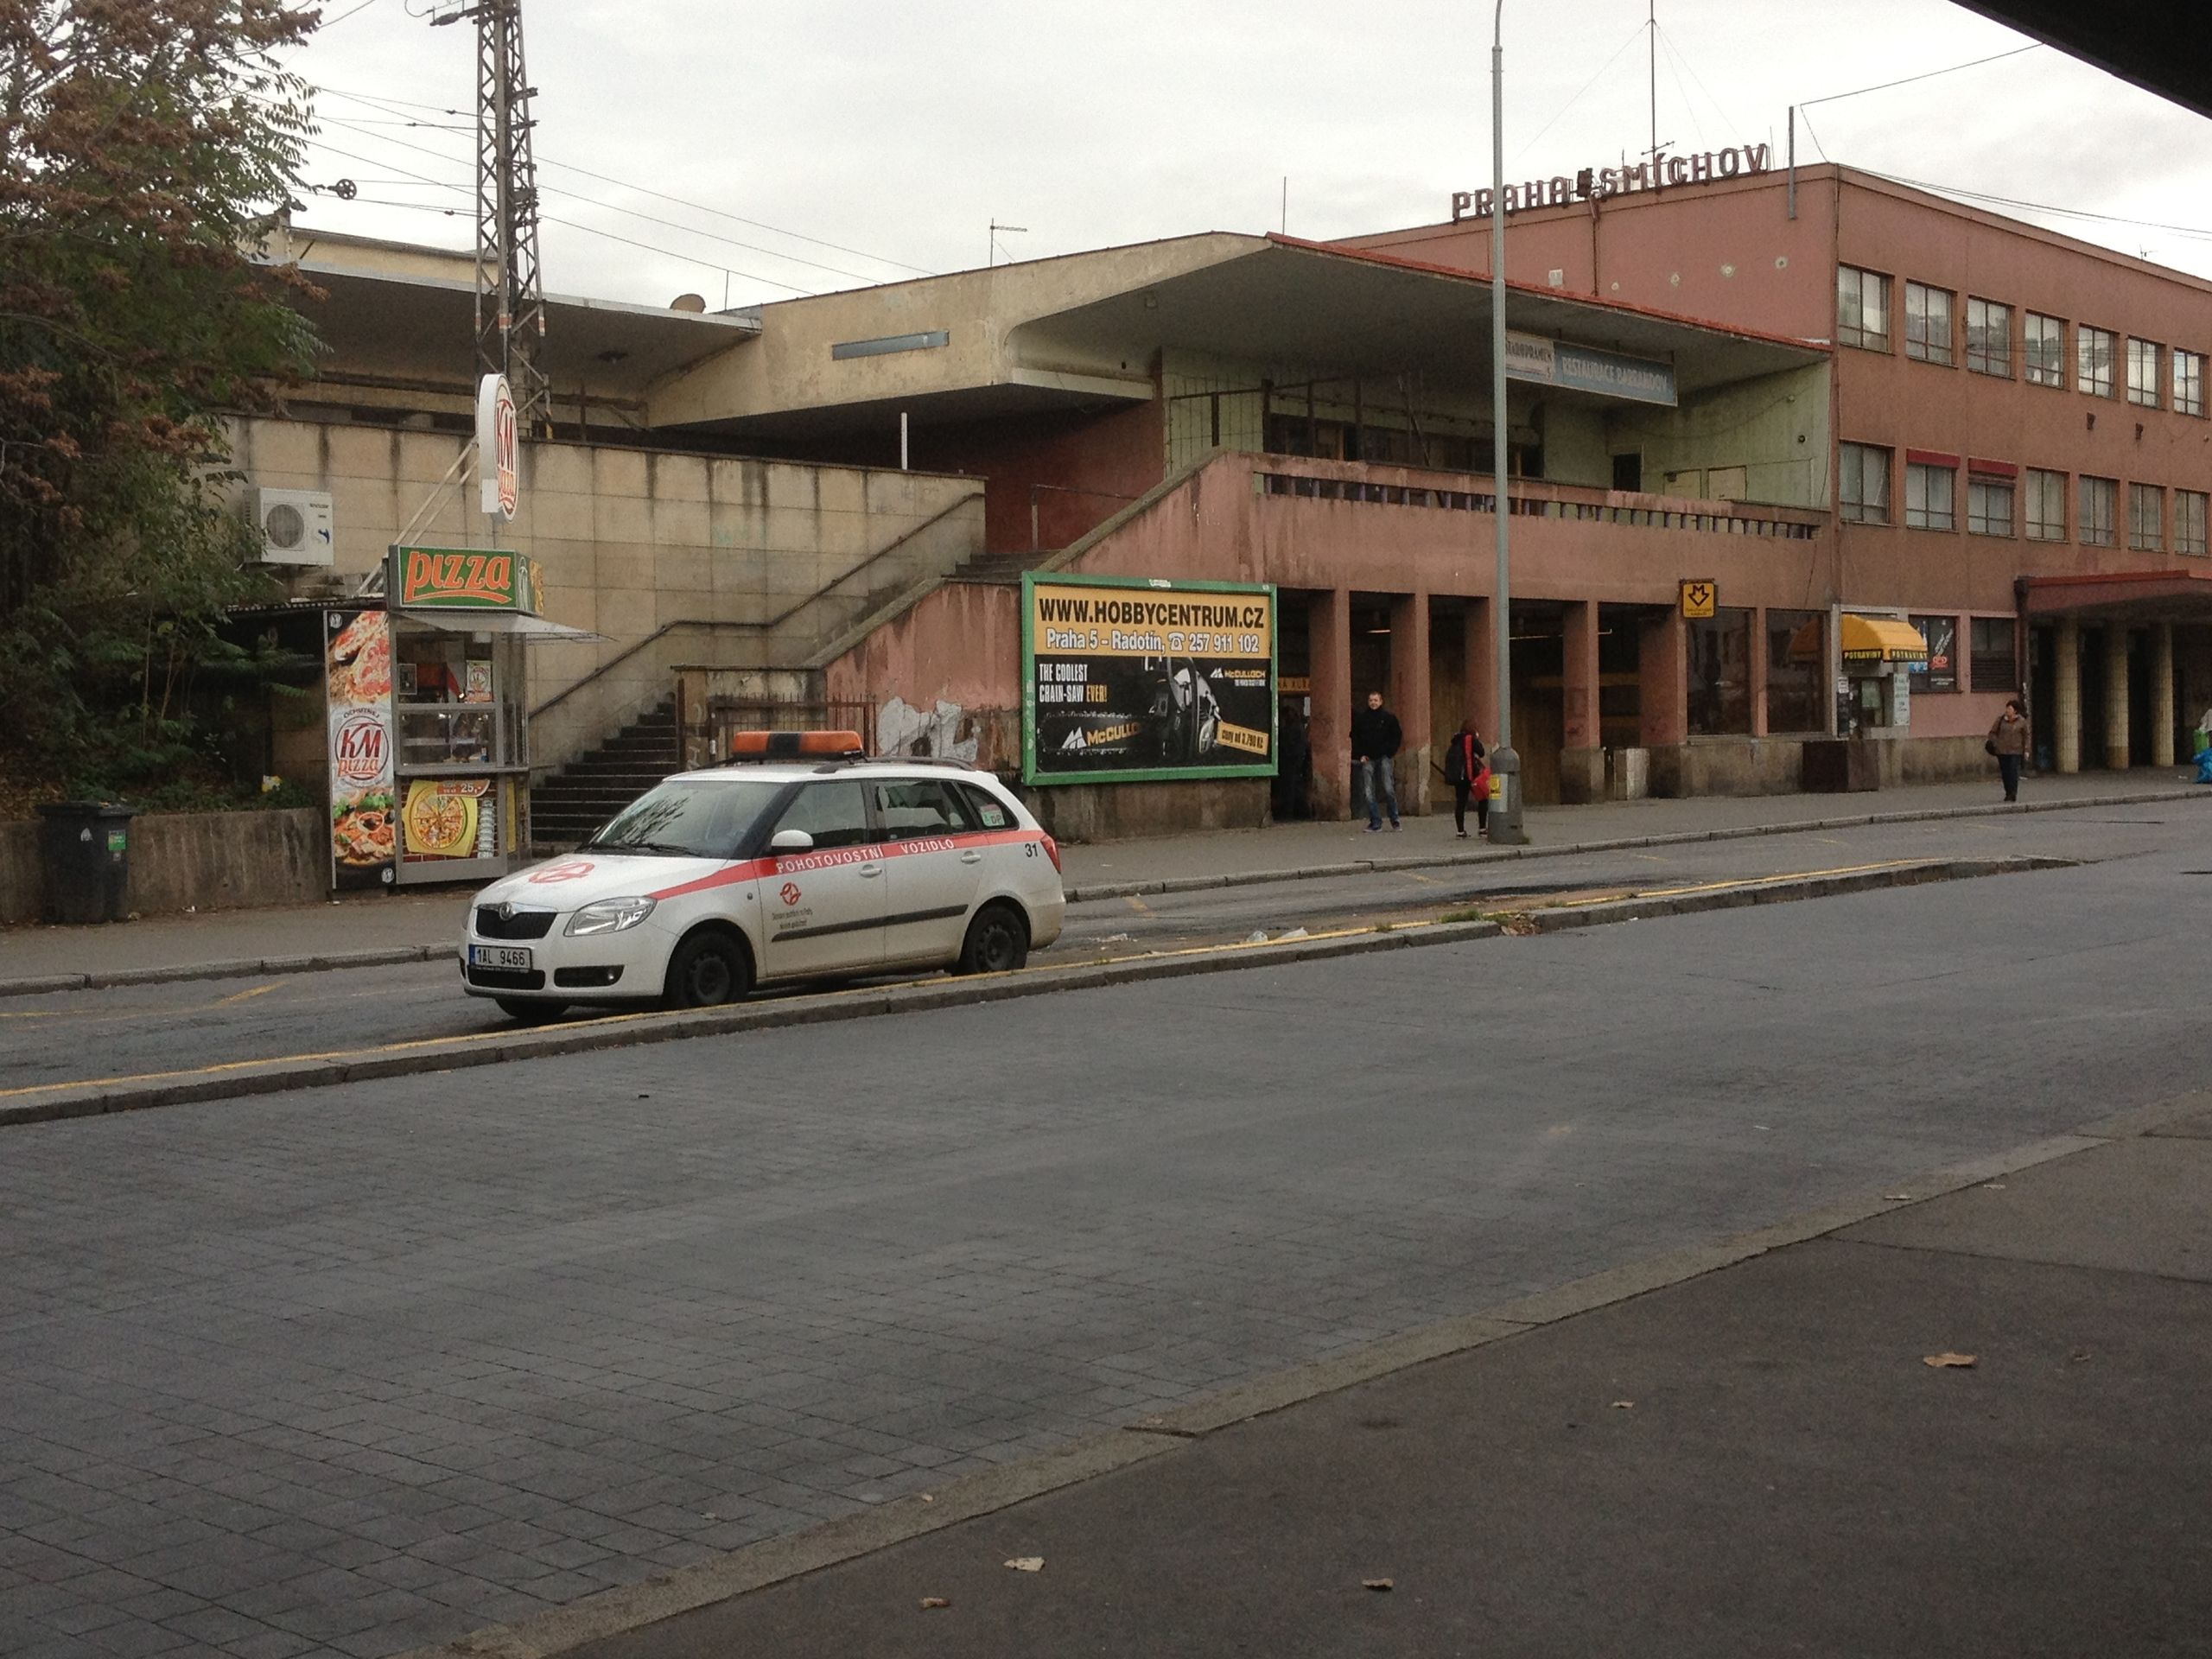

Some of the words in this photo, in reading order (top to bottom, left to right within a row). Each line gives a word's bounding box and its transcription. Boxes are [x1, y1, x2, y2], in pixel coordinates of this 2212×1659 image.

[1452, 176, 1571, 221] PRAHA
[1561, 356, 1614, 384] RESTAURACE
[404, 551, 512, 603] pizza
[1039, 598, 1264, 629] WWW.HOBBYCENTRUM.CZ
[1046, 626, 1086, 649] Praha
[1089, 629, 1099, 650] 5
[1111, 629, 1166, 653] Radotín,
[1188, 632, 1211, 652] 257
[1213, 633, 1234, 652] 911
[1238, 633, 1260, 653] 102
[1844, 650, 1882, 660] POTRAVINY
[1039, 663, 1053, 682] THE
[1055, 663, 1088, 682] COOLEST
[1039, 684, 1084, 702] CHAIN-SAW
[1086, 684, 1108, 702] EVER!
[340, 725, 382, 759] KM
[338, 758, 380, 777] pizza
[776, 845, 884, 874] POHOTOVOSTNÍ
[899, 838, 955, 855] VOZIDLO
[1025, 842, 1039, 858] 31
[477, 948, 493, 964] 1AL
[499, 950, 525, 966] 9466
